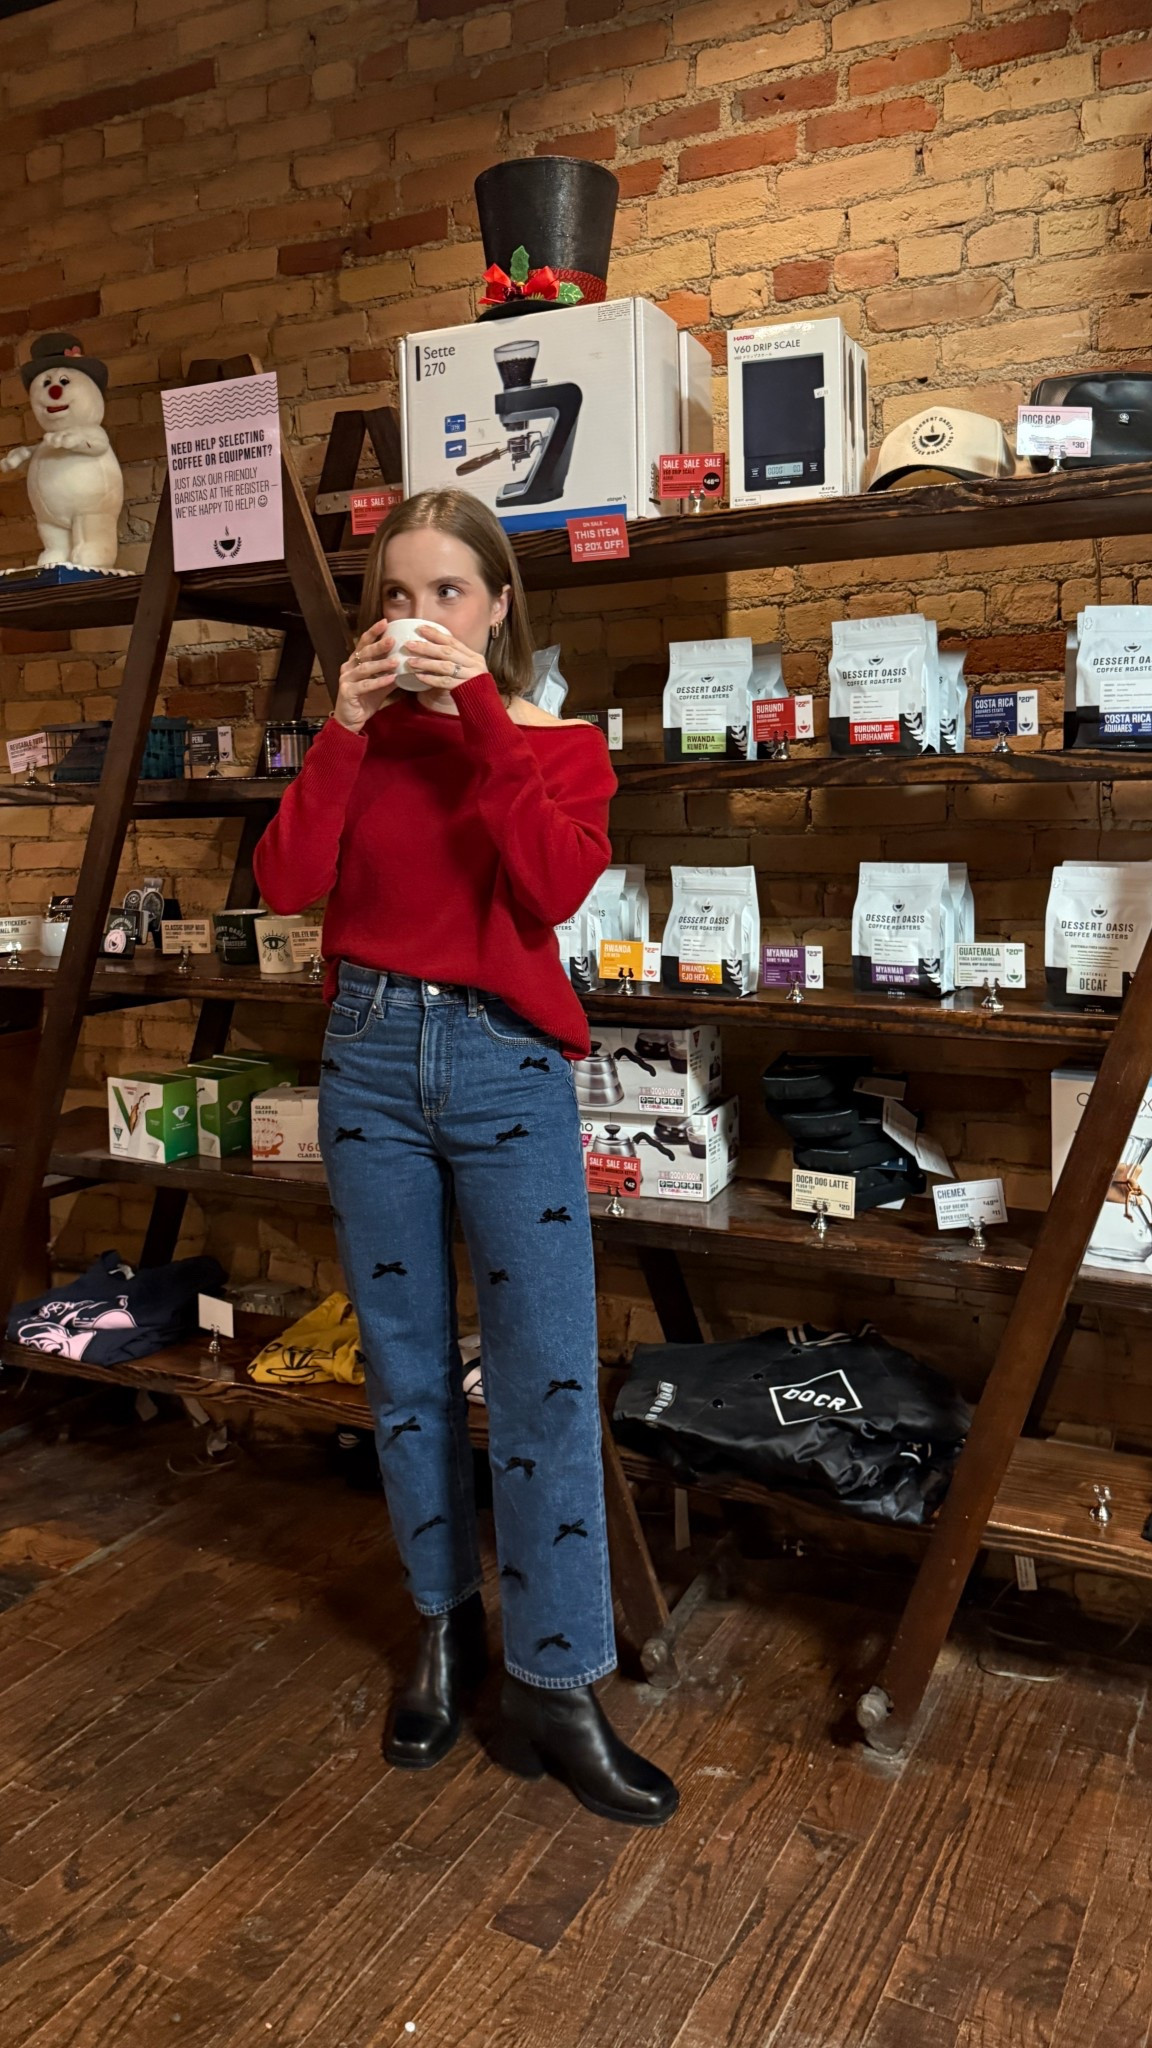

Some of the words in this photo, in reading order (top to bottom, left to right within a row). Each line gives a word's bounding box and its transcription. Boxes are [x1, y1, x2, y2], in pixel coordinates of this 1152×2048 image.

[734, 345, 751, 354] V60
[753, 342, 772, 352] DRIP
[774, 339, 800, 350] SCALE
[424, 346, 456, 360] Sette
[424, 361, 446, 377] 270
[1022, 414, 1043, 425] DOCR
[1045, 415, 1061, 425] CAP
[171, 441, 193, 456] NEED
[195, 437, 216, 452] HELP
[219, 429, 265, 448] SELECTING
[1072, 441, 1085, 449] $30
[172, 455, 203, 471] COFFEE
[205, 453, 217, 466] OR
[219, 444, 273, 464] EQUIPMENT?
[663, 460, 680, 469] SALE
[683, 459, 700, 468] SALE
[704, 458, 721, 468] SALE
[174, 477, 190, 491] JUST
[192, 474, 207, 488] ASK
[208, 472, 223, 486] OUR
[224, 467, 258, 483] FRIENDLY
[174, 488, 208, 505] BARISTAS
[209, 487, 218, 497] AT
[220, 485, 234, 498] THE
[235, 479, 270, 496] REGISTER
[175, 504, 198, 519] WE'RE
[199, 502, 222, 516] HAPPY
[224, 500, 234, 512] TO
[235, 496, 256, 511] HELP!
[354, 499, 368, 508] SALE
[371, 497, 385, 507] SALE
[387, 495, 402, 505] SALE
[574, 530, 596, 540] THIS
[597, 527, 619, 538] ITEM
[574, 543, 583, 552] IS
[585, 542, 603, 552] 20%
[604, 539, 624, 550] OFF!
[1093, 656, 1135, 666] DESSERT
[842, 669, 879, 679] DESSERT
[881, 667, 907, 677] OASIS
[676, 686, 709, 694] DESSERT
[712, 684, 733, 692] OASIS
[756, 703, 784, 714] BURUNDI
[975, 698, 996, 709] COSTA
[997, 697, 1014, 708] RICA
[1104, 714, 1130, 723] COSTA
[1132, 713, 1151, 723] RICA
[854, 724, 882, 733] BURUNDI
[854, 732, 893, 741] TURIHAMWE
[9, 740, 32, 751] REUSABLE
[678, 916, 708, 924] DESSERT
[866, 914, 900, 924] DESSERT
[902, 915, 925, 923] OASIS
[1061, 920, 1102, 931] DESSERT
[1106, 923, 1134, 932] OASIS
[604, 944, 632, 953] RWANDA
[766, 949, 798, 958] MYANMAR
[959, 947, 1000, 956] GUATEMALA
[682, 964, 706, 973] RWANDA
[875, 966, 904, 974] MYANMAR
[694, 973, 709, 981] HEZA
[1079, 978, 1108, 992] DECAF
[589, 1157, 603, 1166] SALE
[606, 1159, 620, 1169] SALE
[624, 1161, 638, 1171] SALE
[796, 1175, 813, 1184] DOCR
[814, 1177, 828, 1187] DOG
[829, 1179, 849, 1190] LATTE
[937, 1187, 966, 1199] CHEMEX
[782, 1388, 846, 1411] DOCR
